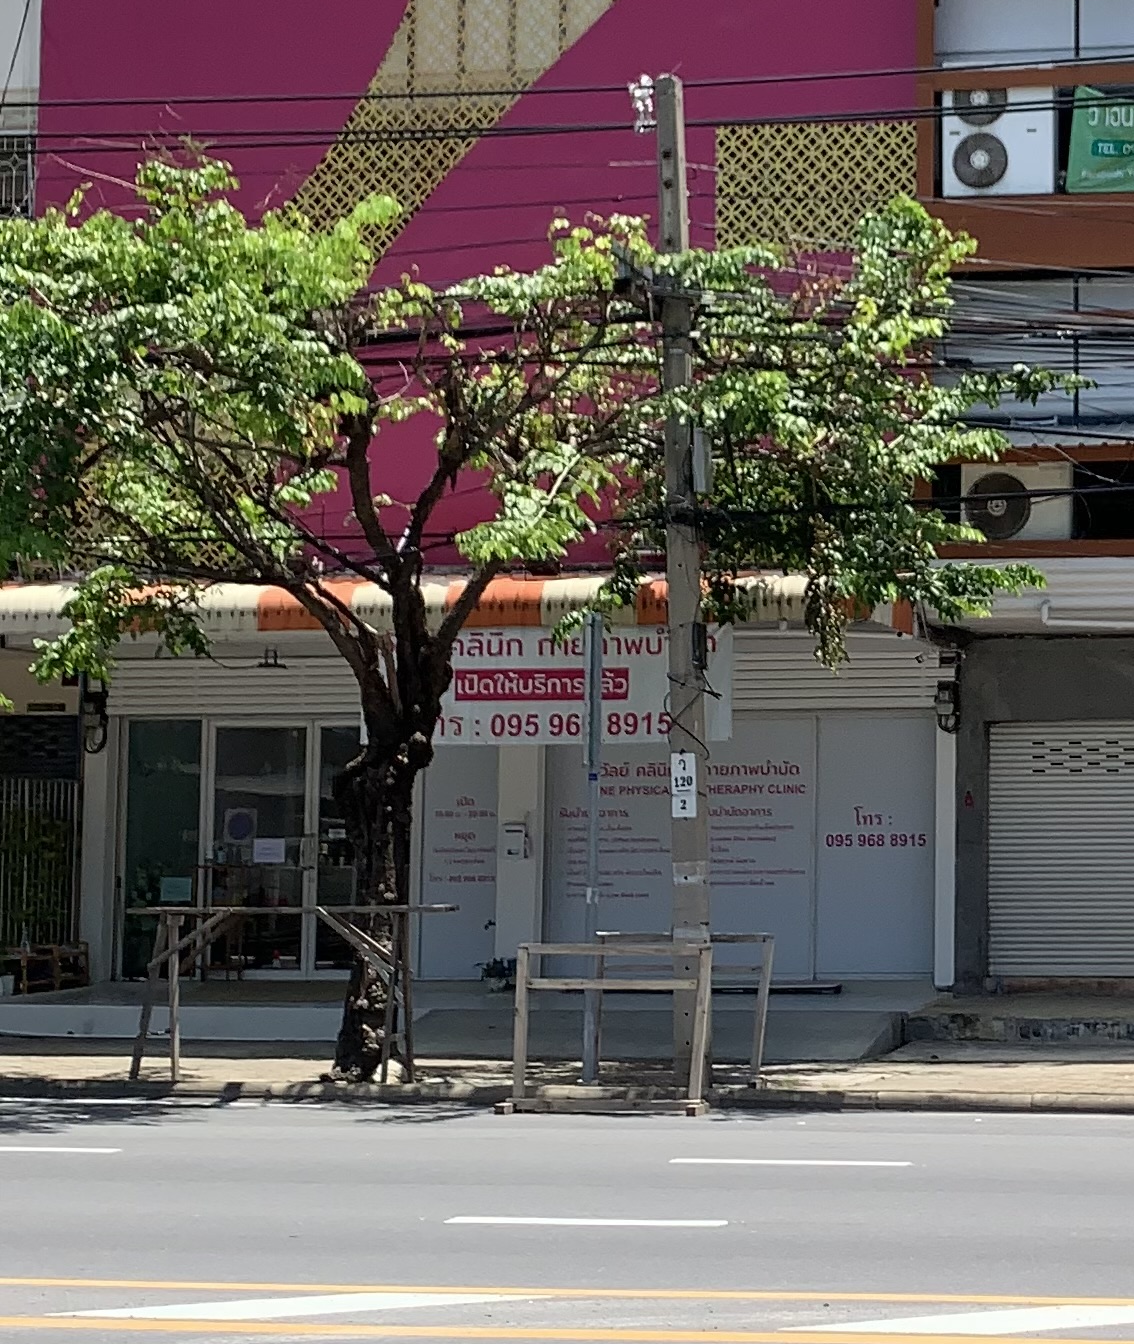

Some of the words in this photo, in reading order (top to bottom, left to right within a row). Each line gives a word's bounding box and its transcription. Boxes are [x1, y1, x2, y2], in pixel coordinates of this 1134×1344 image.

[491, 714, 539, 736] 095
[549, 713, 580, 736] 96
[607, 712, 673, 735] 8915
[637, 762, 671, 777] คลินิ
[674, 776, 693, 788] 120
[620, 785, 670, 795] PHYSICA
[768, 784, 806, 794] CLINIC
[680, 799, 688, 810] 2
[853, 805, 882, 826] โทร
[826, 834, 853, 847] 095
[858, 834, 885, 847] 968
[890, 833, 927, 847] 8915
